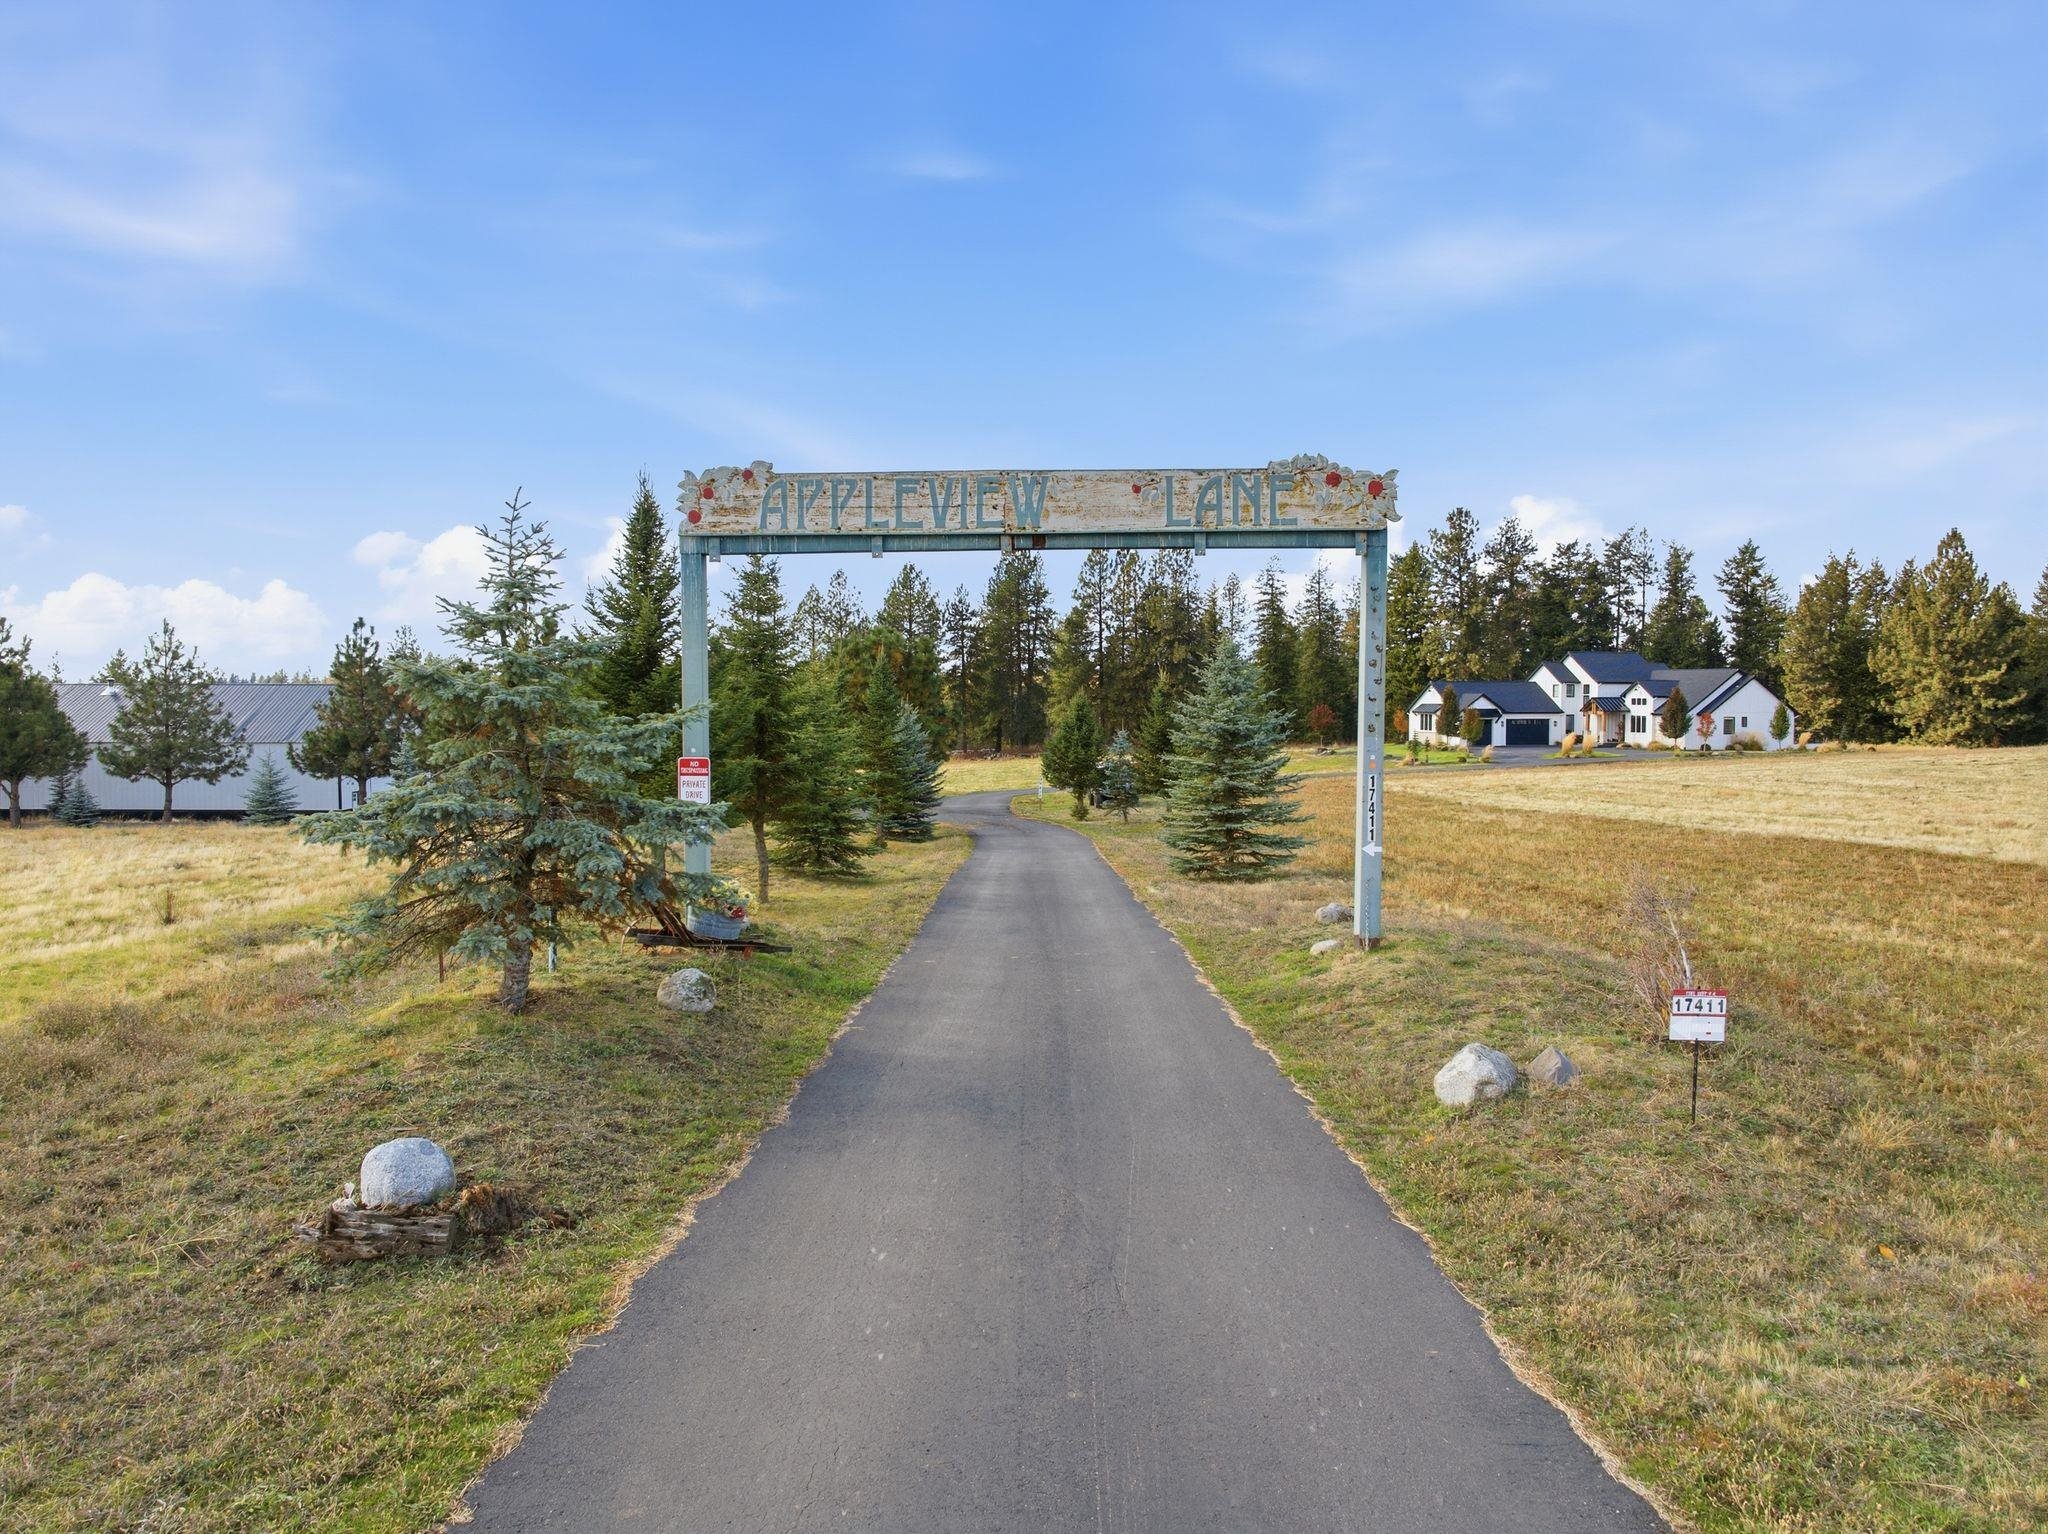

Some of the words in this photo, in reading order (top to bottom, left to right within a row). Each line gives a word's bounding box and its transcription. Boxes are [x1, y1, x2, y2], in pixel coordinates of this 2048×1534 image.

[759, 475, 1051, 530] APPLEVIEW
[1165, 474, 1298, 528] LANE
[682, 780, 706, 789] PRIVATE
[685, 790, 704, 799] DRIVE
[1368, 775, 1376, 841] 17411
[1675, 998, 1724, 1013] 17411
